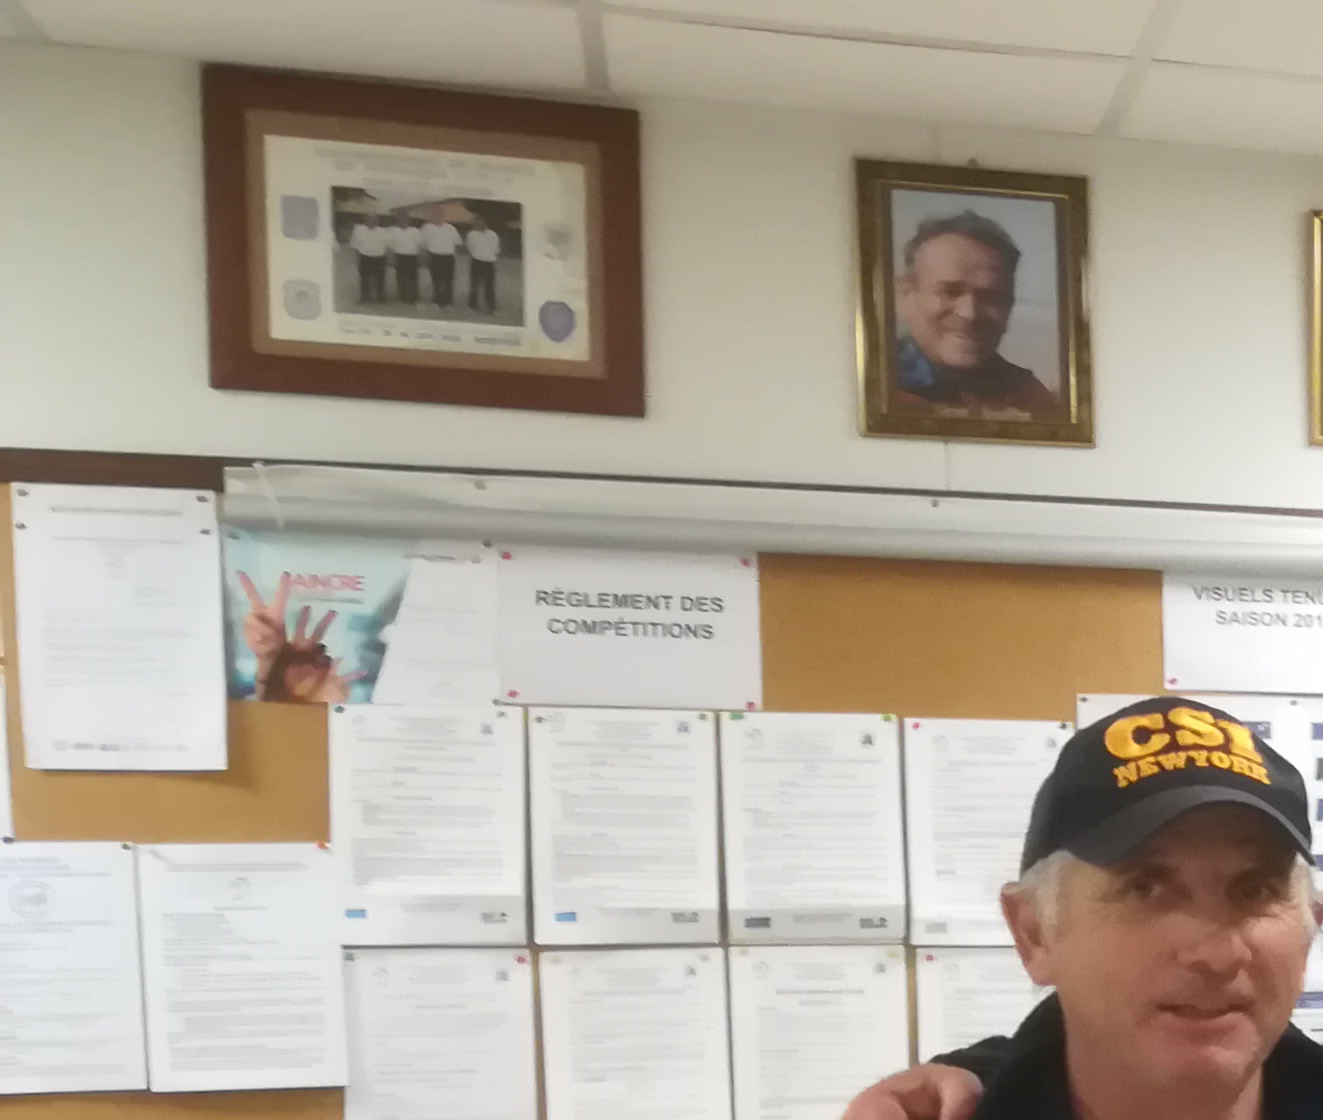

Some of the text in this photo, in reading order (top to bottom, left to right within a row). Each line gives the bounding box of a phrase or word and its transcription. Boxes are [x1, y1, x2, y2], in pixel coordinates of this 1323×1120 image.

[1191, 584, 1275, 603] VISUELS
[680, 596, 724, 612] DES
[547, 617, 714, 639] COMPÉTITIONS
[1215, 610, 1288, 627] SAISON
[1103, 706, 1264, 766] CSI
